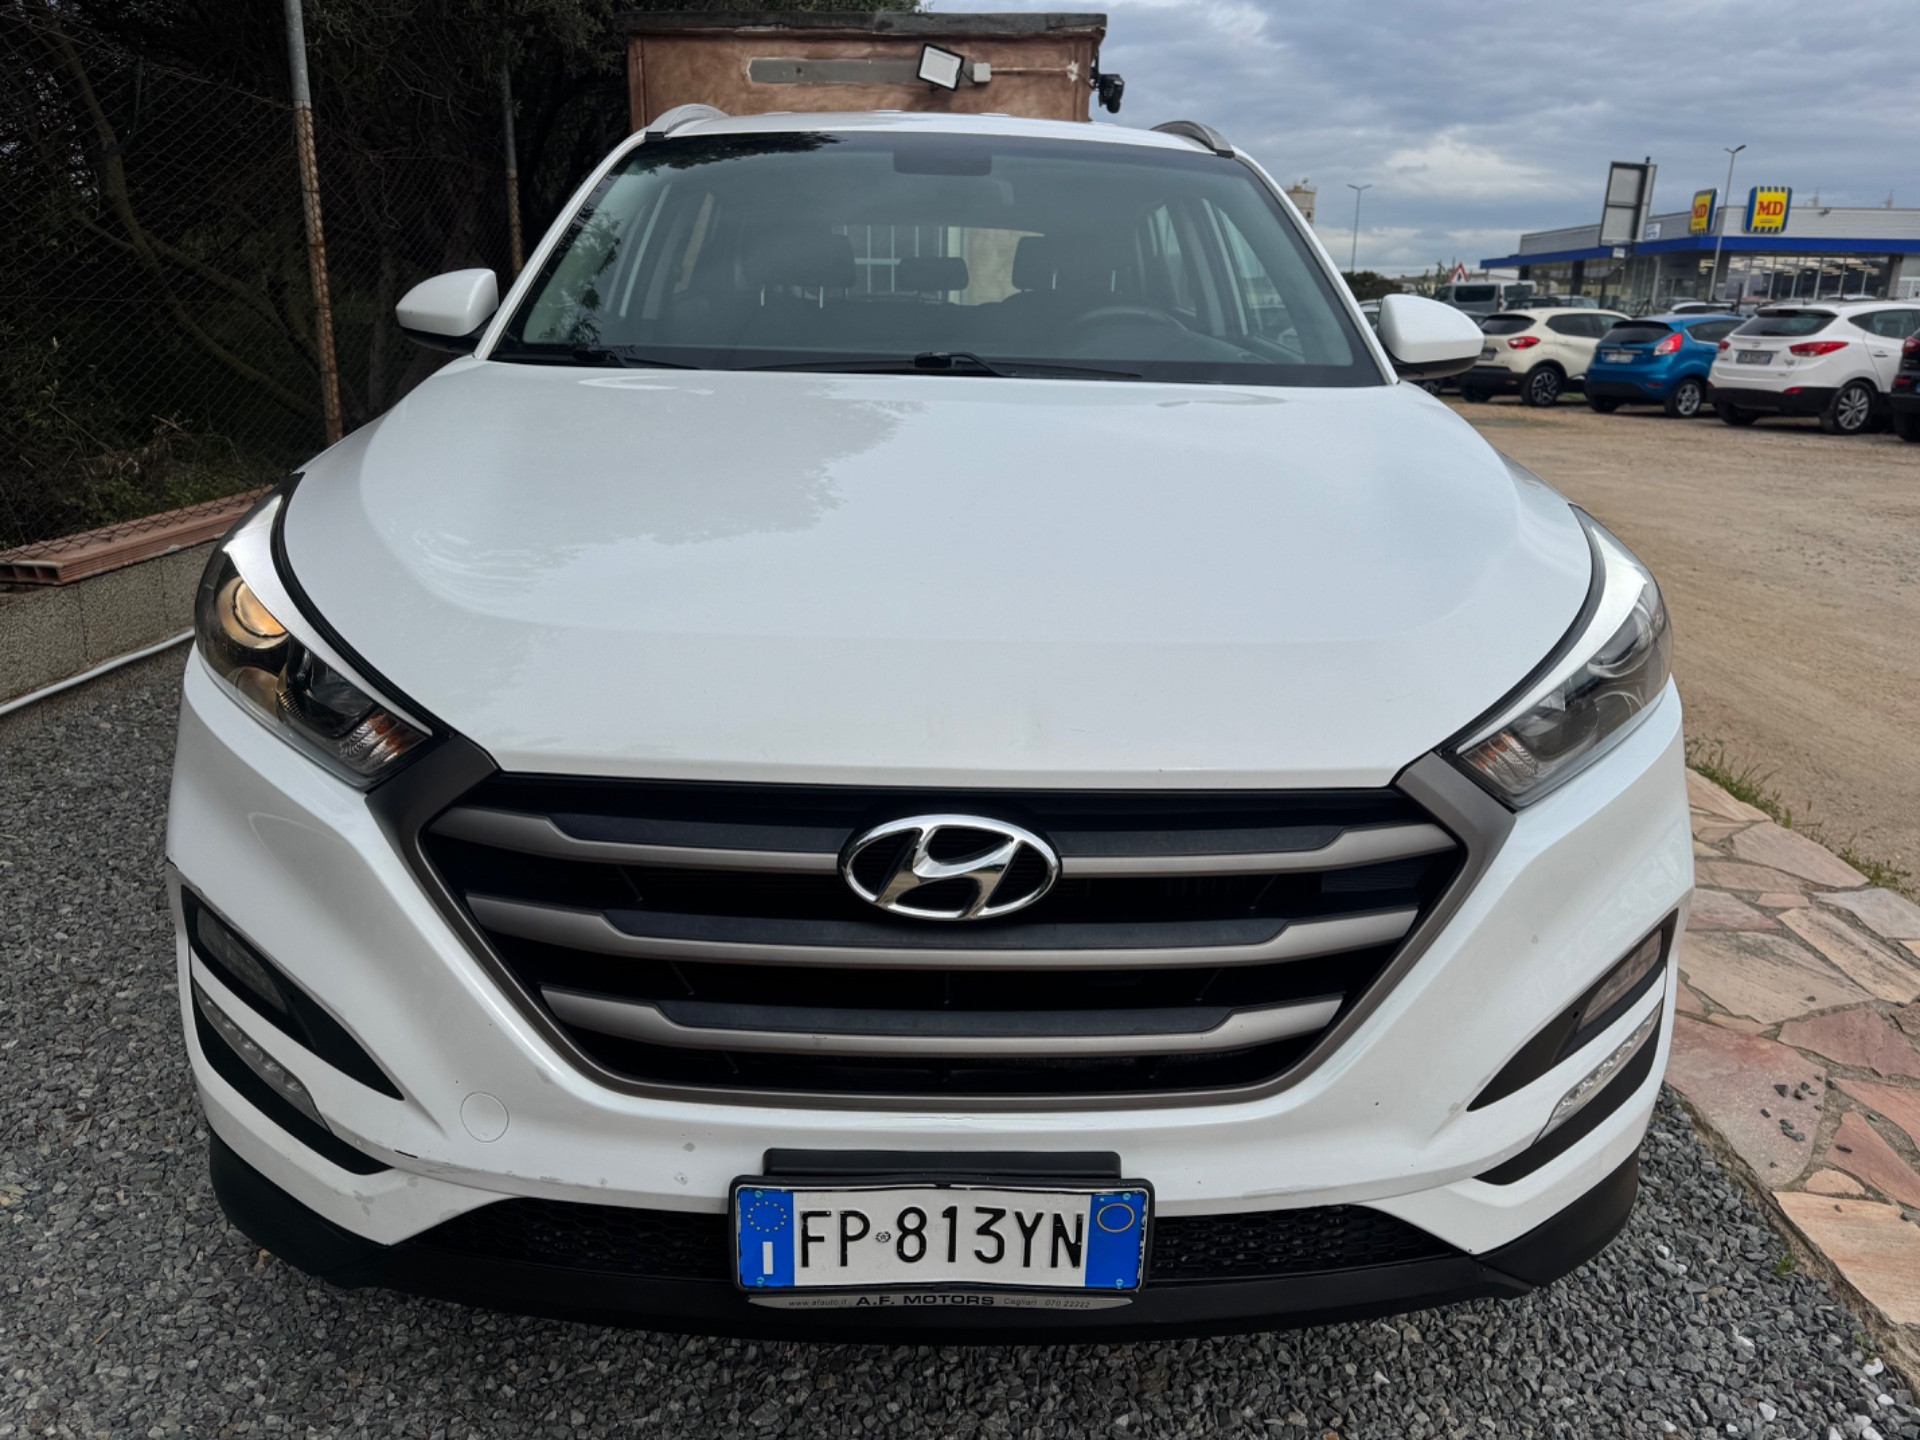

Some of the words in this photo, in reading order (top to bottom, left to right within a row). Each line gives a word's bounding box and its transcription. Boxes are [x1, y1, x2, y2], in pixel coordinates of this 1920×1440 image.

[1757, 200, 1784, 216] MD
[800, 1209, 871, 1268] FP
[896, 1205, 1085, 1269] 813YN
[856, 1296, 895, 1306] A.F.
[903, 1295, 995, 1306] MOTORS
[1003, 1297, 1037, 1307] Cagliari
